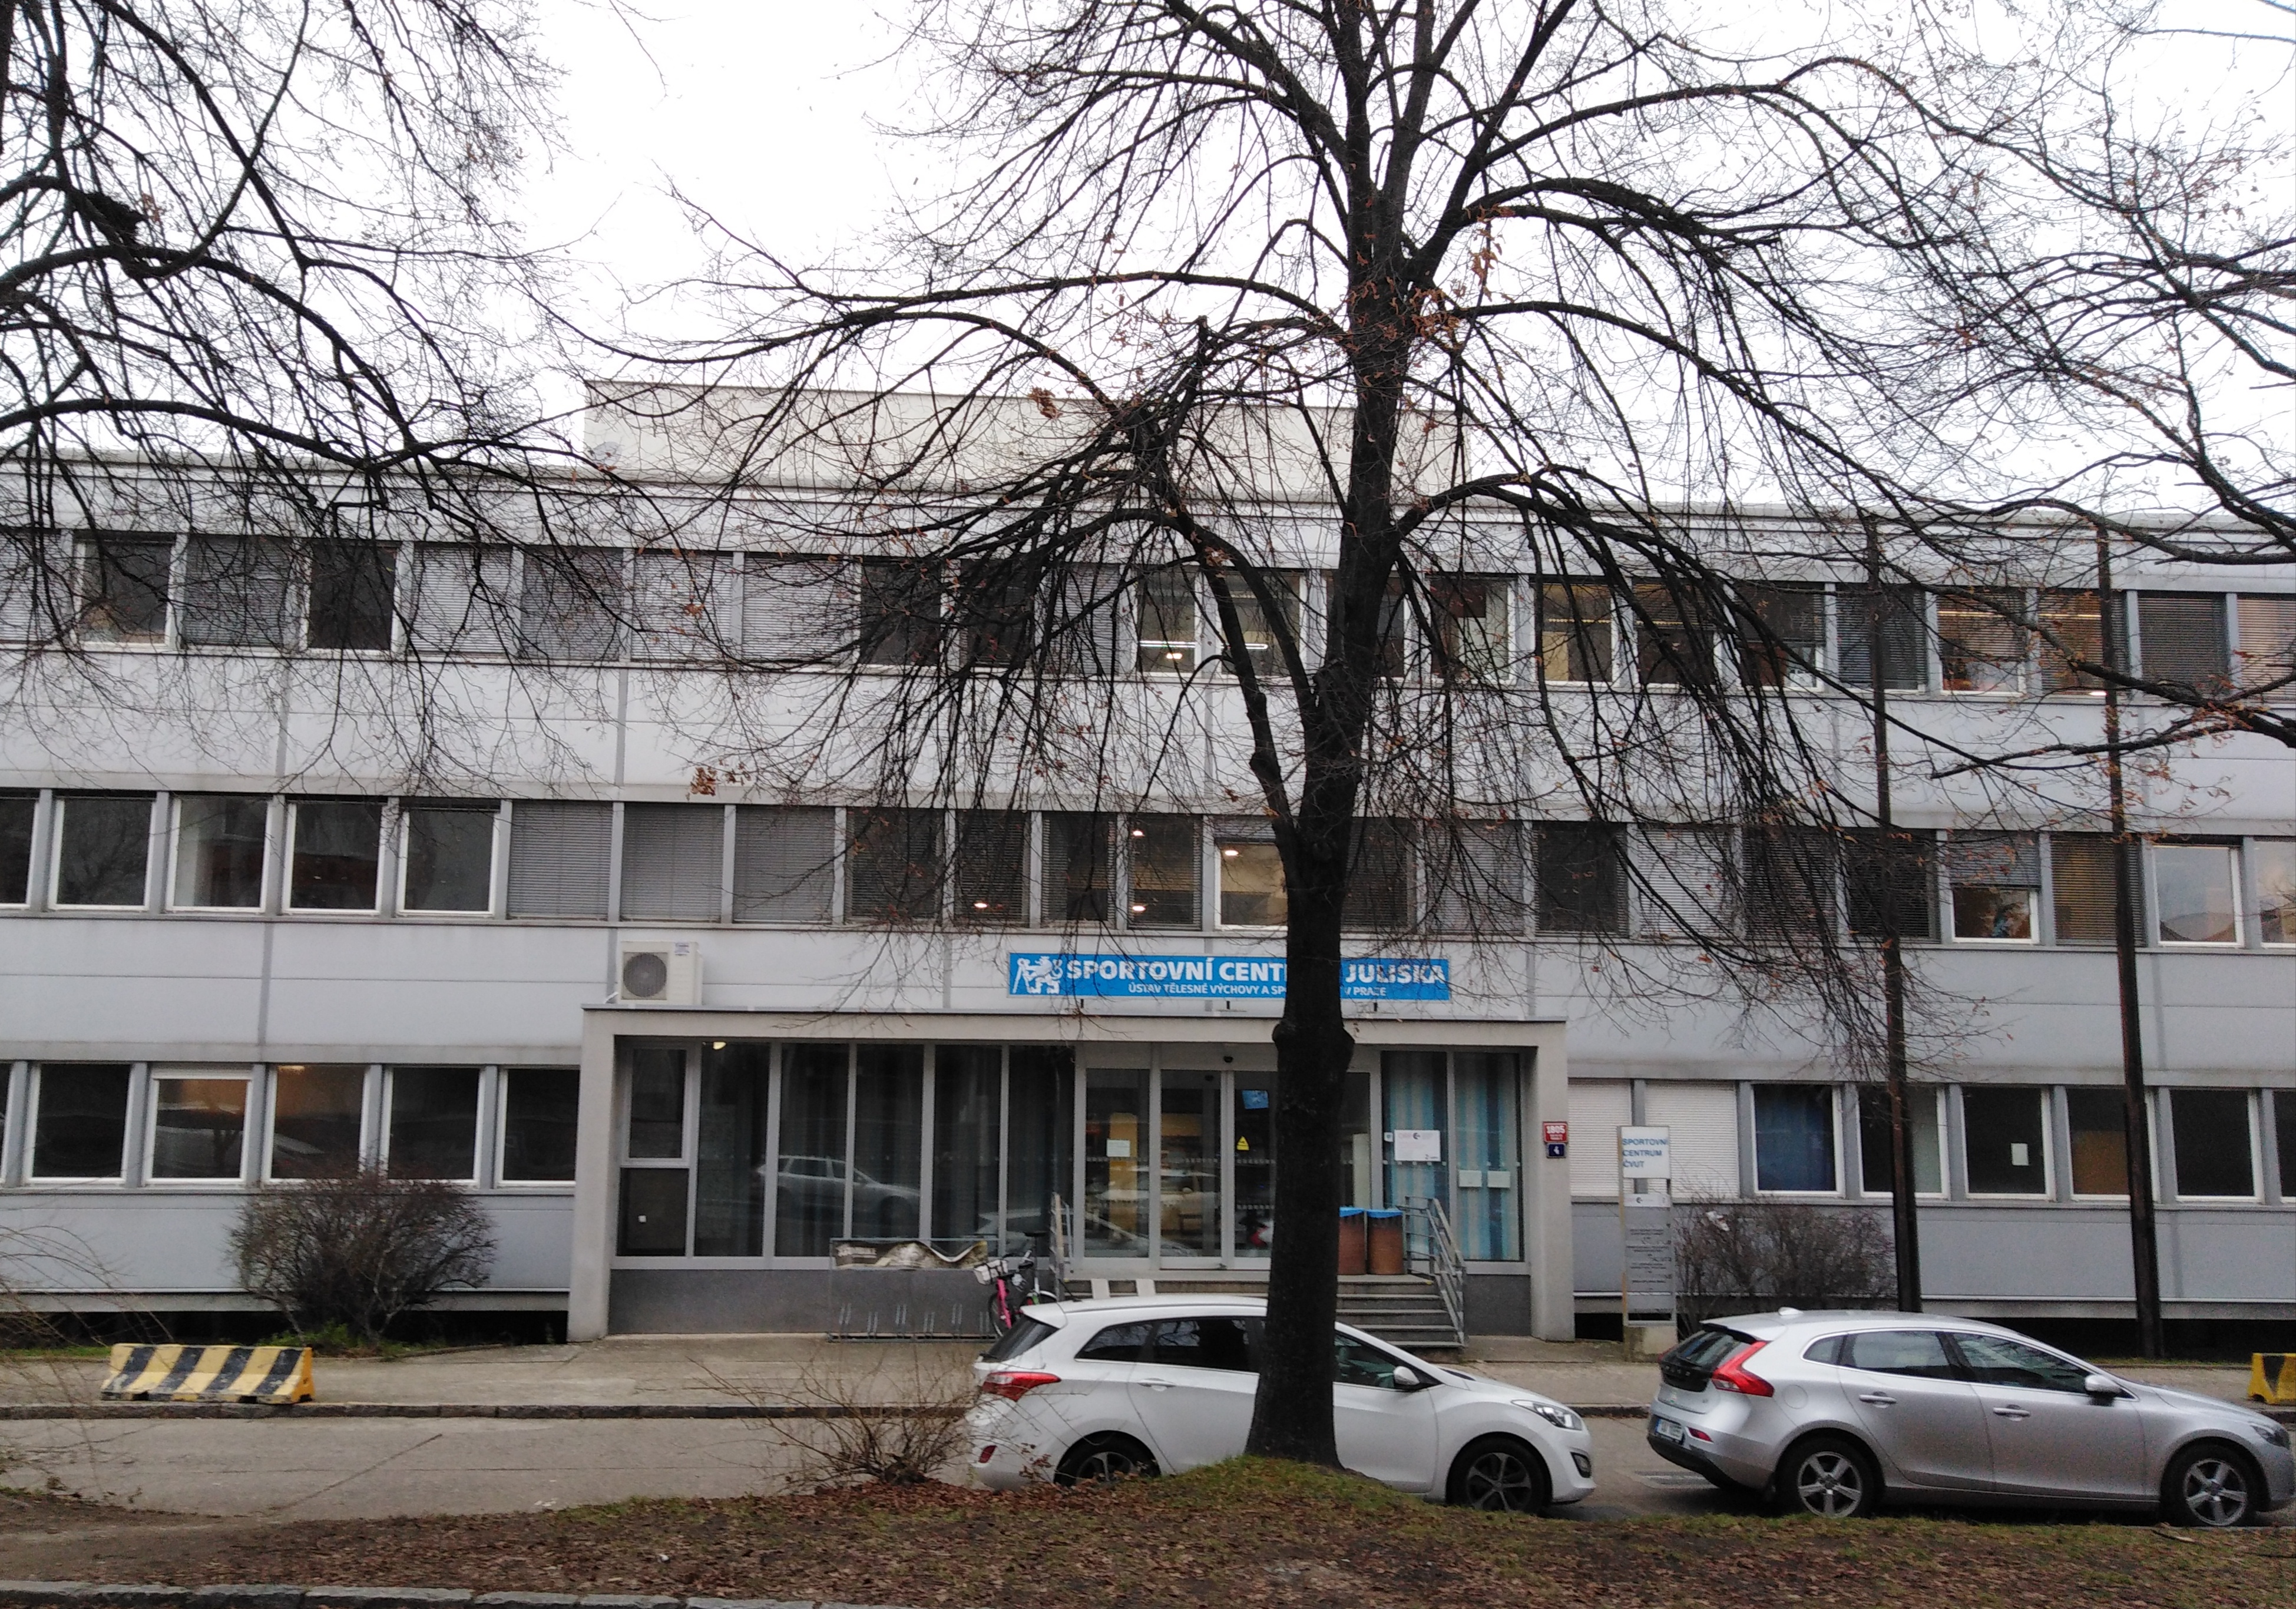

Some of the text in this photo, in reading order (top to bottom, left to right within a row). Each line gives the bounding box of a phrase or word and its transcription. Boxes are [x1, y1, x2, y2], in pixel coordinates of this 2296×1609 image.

[1067, 958, 1214, 980] SPORTOVNÍ
[1345, 964, 1445, 984] JULISKA
[1129, 982, 1161, 994] ÚSTAV
[1164, 982, 1207, 994] TĚLESNÉ
[1209, 984, 1259, 994] VÝCHOVY
[1261, 986, 1269, 994] A
[1271, 986, 1287, 995] SP
